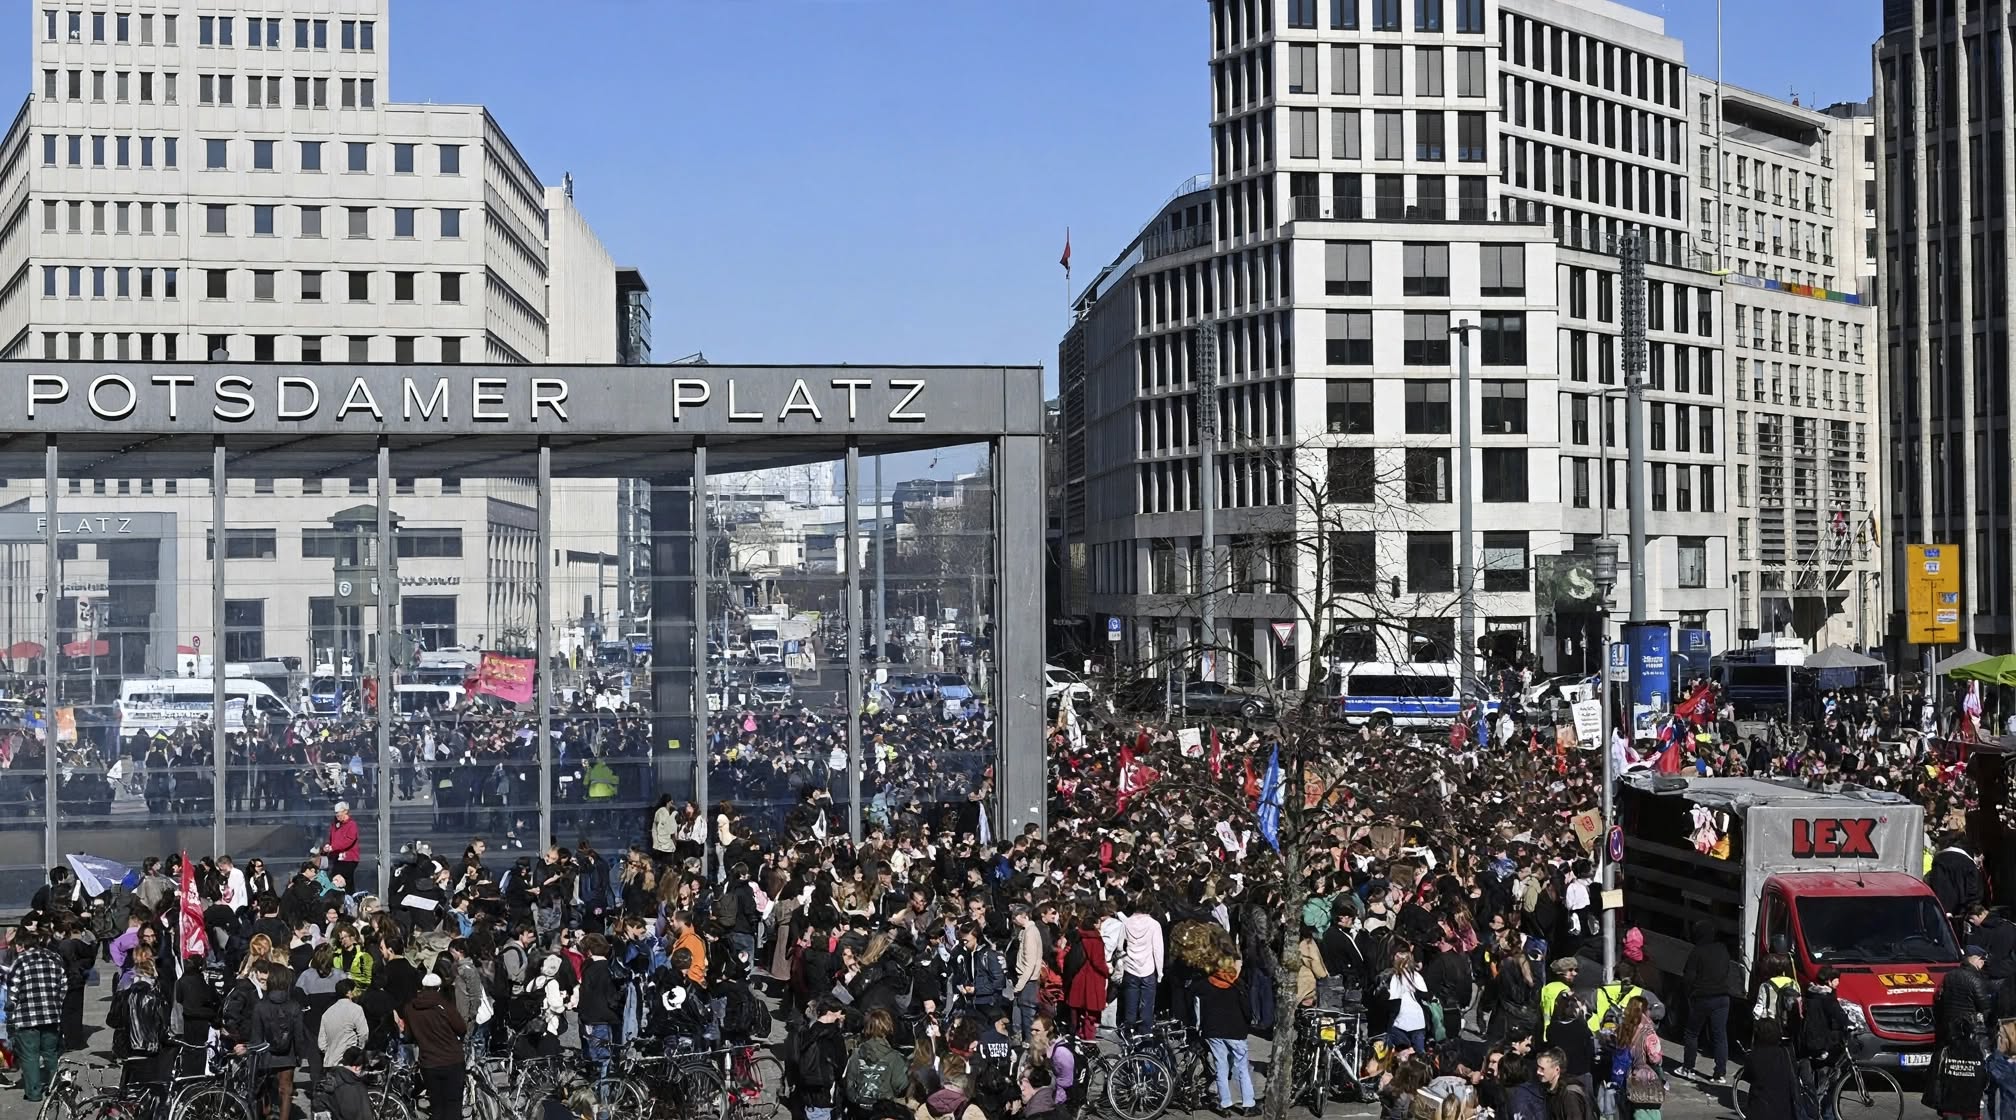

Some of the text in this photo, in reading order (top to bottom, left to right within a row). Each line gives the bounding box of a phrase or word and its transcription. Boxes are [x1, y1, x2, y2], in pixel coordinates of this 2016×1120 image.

[27, 374, 926, 423] POTSDAMER PLATZ
[1792, 818, 1879, 859] LEX
